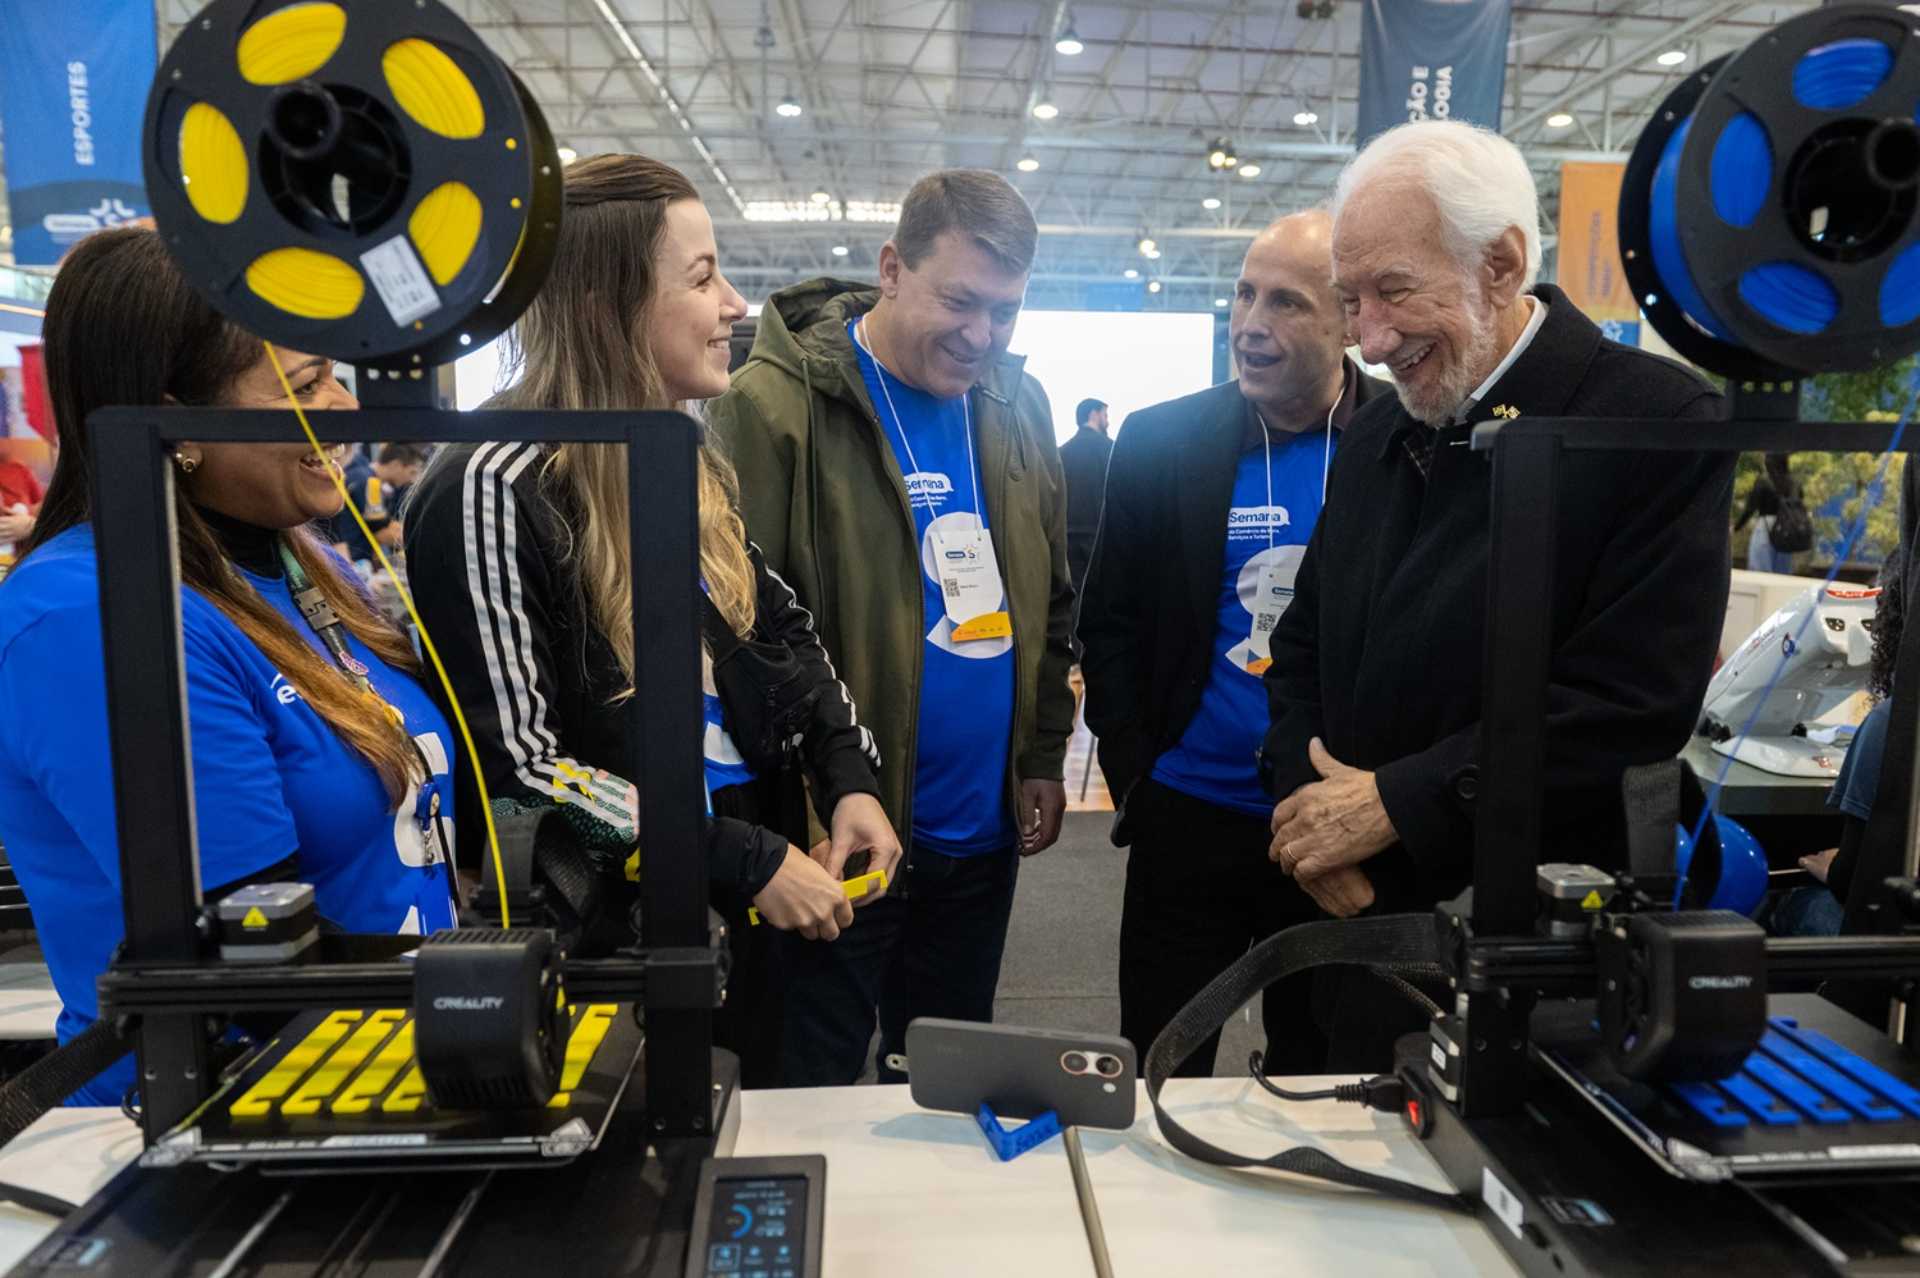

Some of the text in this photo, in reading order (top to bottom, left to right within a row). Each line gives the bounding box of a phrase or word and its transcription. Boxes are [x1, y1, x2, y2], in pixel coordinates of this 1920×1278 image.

[1406, 81, 1428, 122] ÇÃO
[1433, 65, 1453, 119] OGIA
[67, 61, 95, 165] ESPORTES
[1687, 975, 1753, 989] CREALITY
[433, 996, 504, 1010] CREALITY
